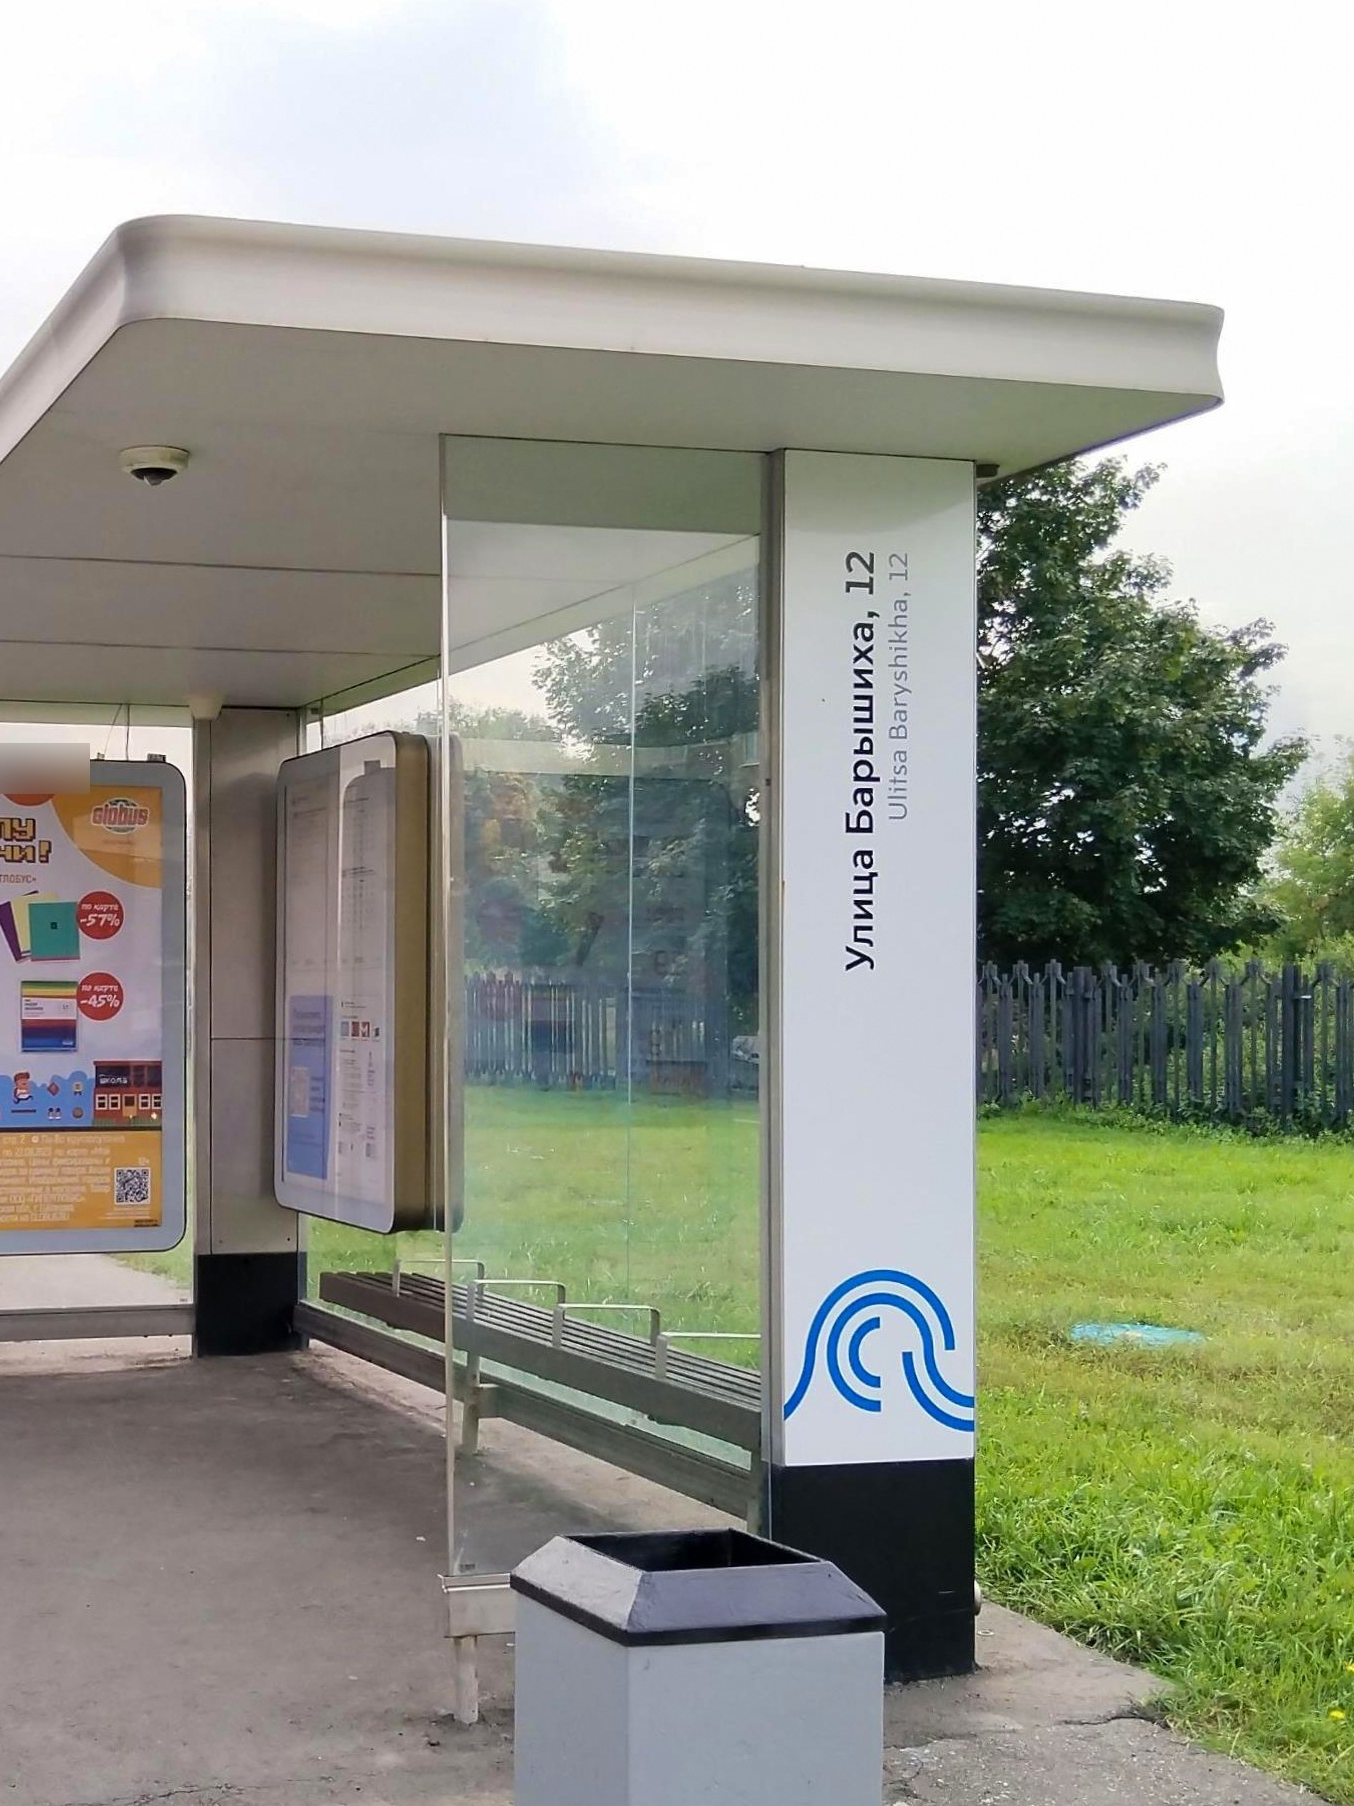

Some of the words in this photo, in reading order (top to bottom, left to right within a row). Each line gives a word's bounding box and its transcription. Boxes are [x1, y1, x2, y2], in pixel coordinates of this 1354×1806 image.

[845, 552, 875, 595] 12
[888, 553, 908, 581] 12
[887, 592, 912, 740] Baryshikha,
[845, 610, 881, 835] Барышиха,
[888, 750, 909, 821] Ulitsa
[845, 850, 879, 971] Улица
